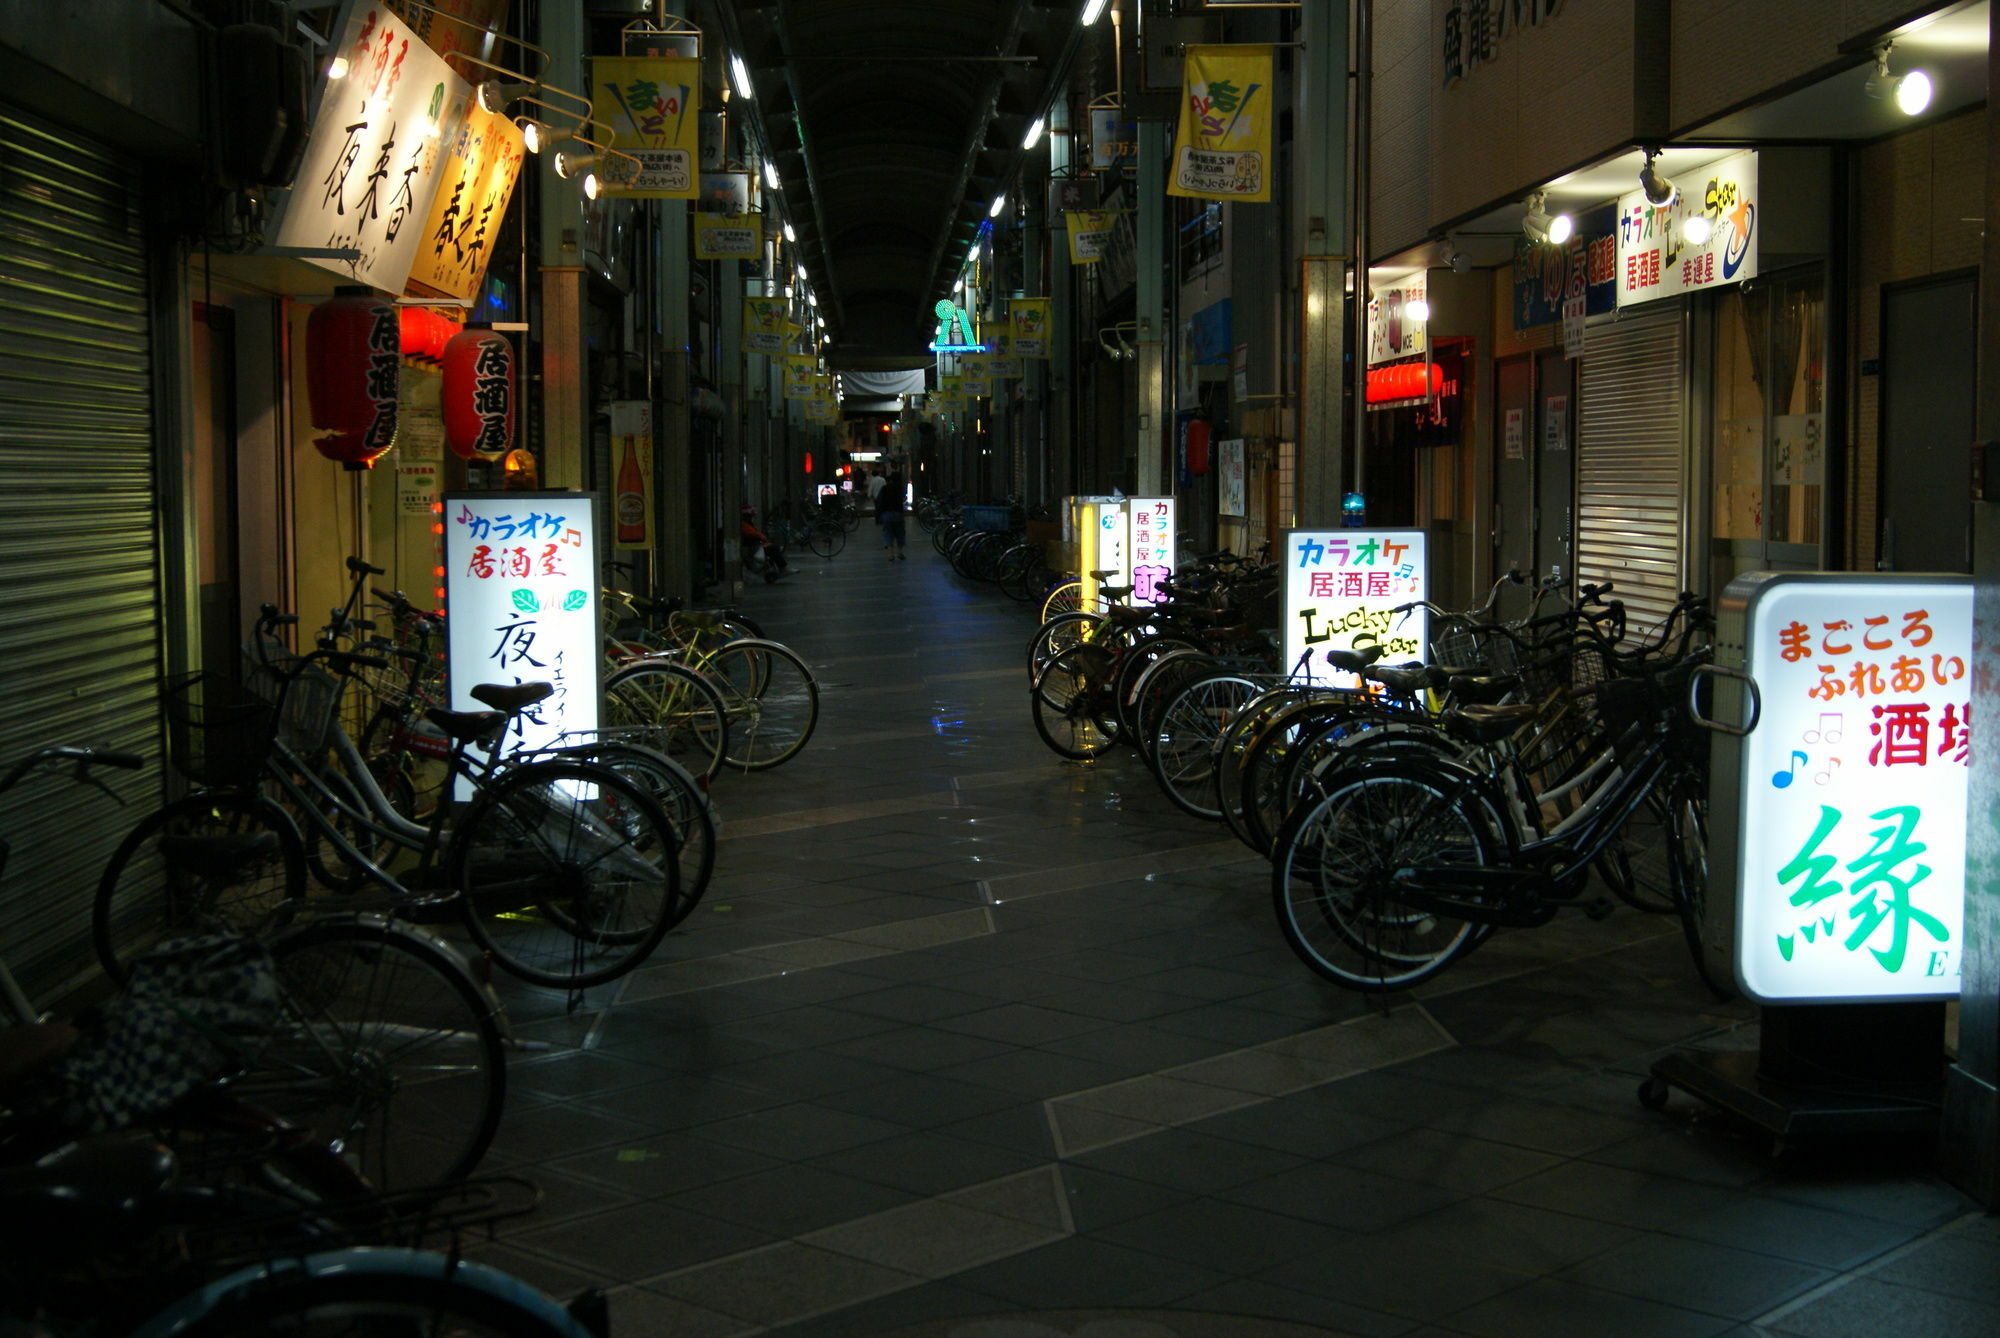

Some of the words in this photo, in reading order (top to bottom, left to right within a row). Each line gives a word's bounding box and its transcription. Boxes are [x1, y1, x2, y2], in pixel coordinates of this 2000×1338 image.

[322, 101, 424, 245] 夜来香
[1626, 249, 1660, 291] 居酒屋
[1682, 252, 1715, 288] 幸運星
[364, 304, 400, 451] 居酒屋
[473, 339, 511, 454] 居酒屋
[469, 512, 566, 541] カラオケ
[1136, 512, 1150, 561] 居酒屋
[1154, 501, 1168, 561] カラオケ
[466, 543, 567, 580] 居酒屋
[1298, 538, 1409, 568] カラオケ
[1309, 571, 1391, 598] 居酒屋
[1299, 606, 1395, 645] Lucky
[1779, 609, 1934, 663] まごころ
[1808, 653, 1965, 701] ふれあい
[1776, 804, 1950, 973] 縁
[1924, 950, 1962, 977] E
